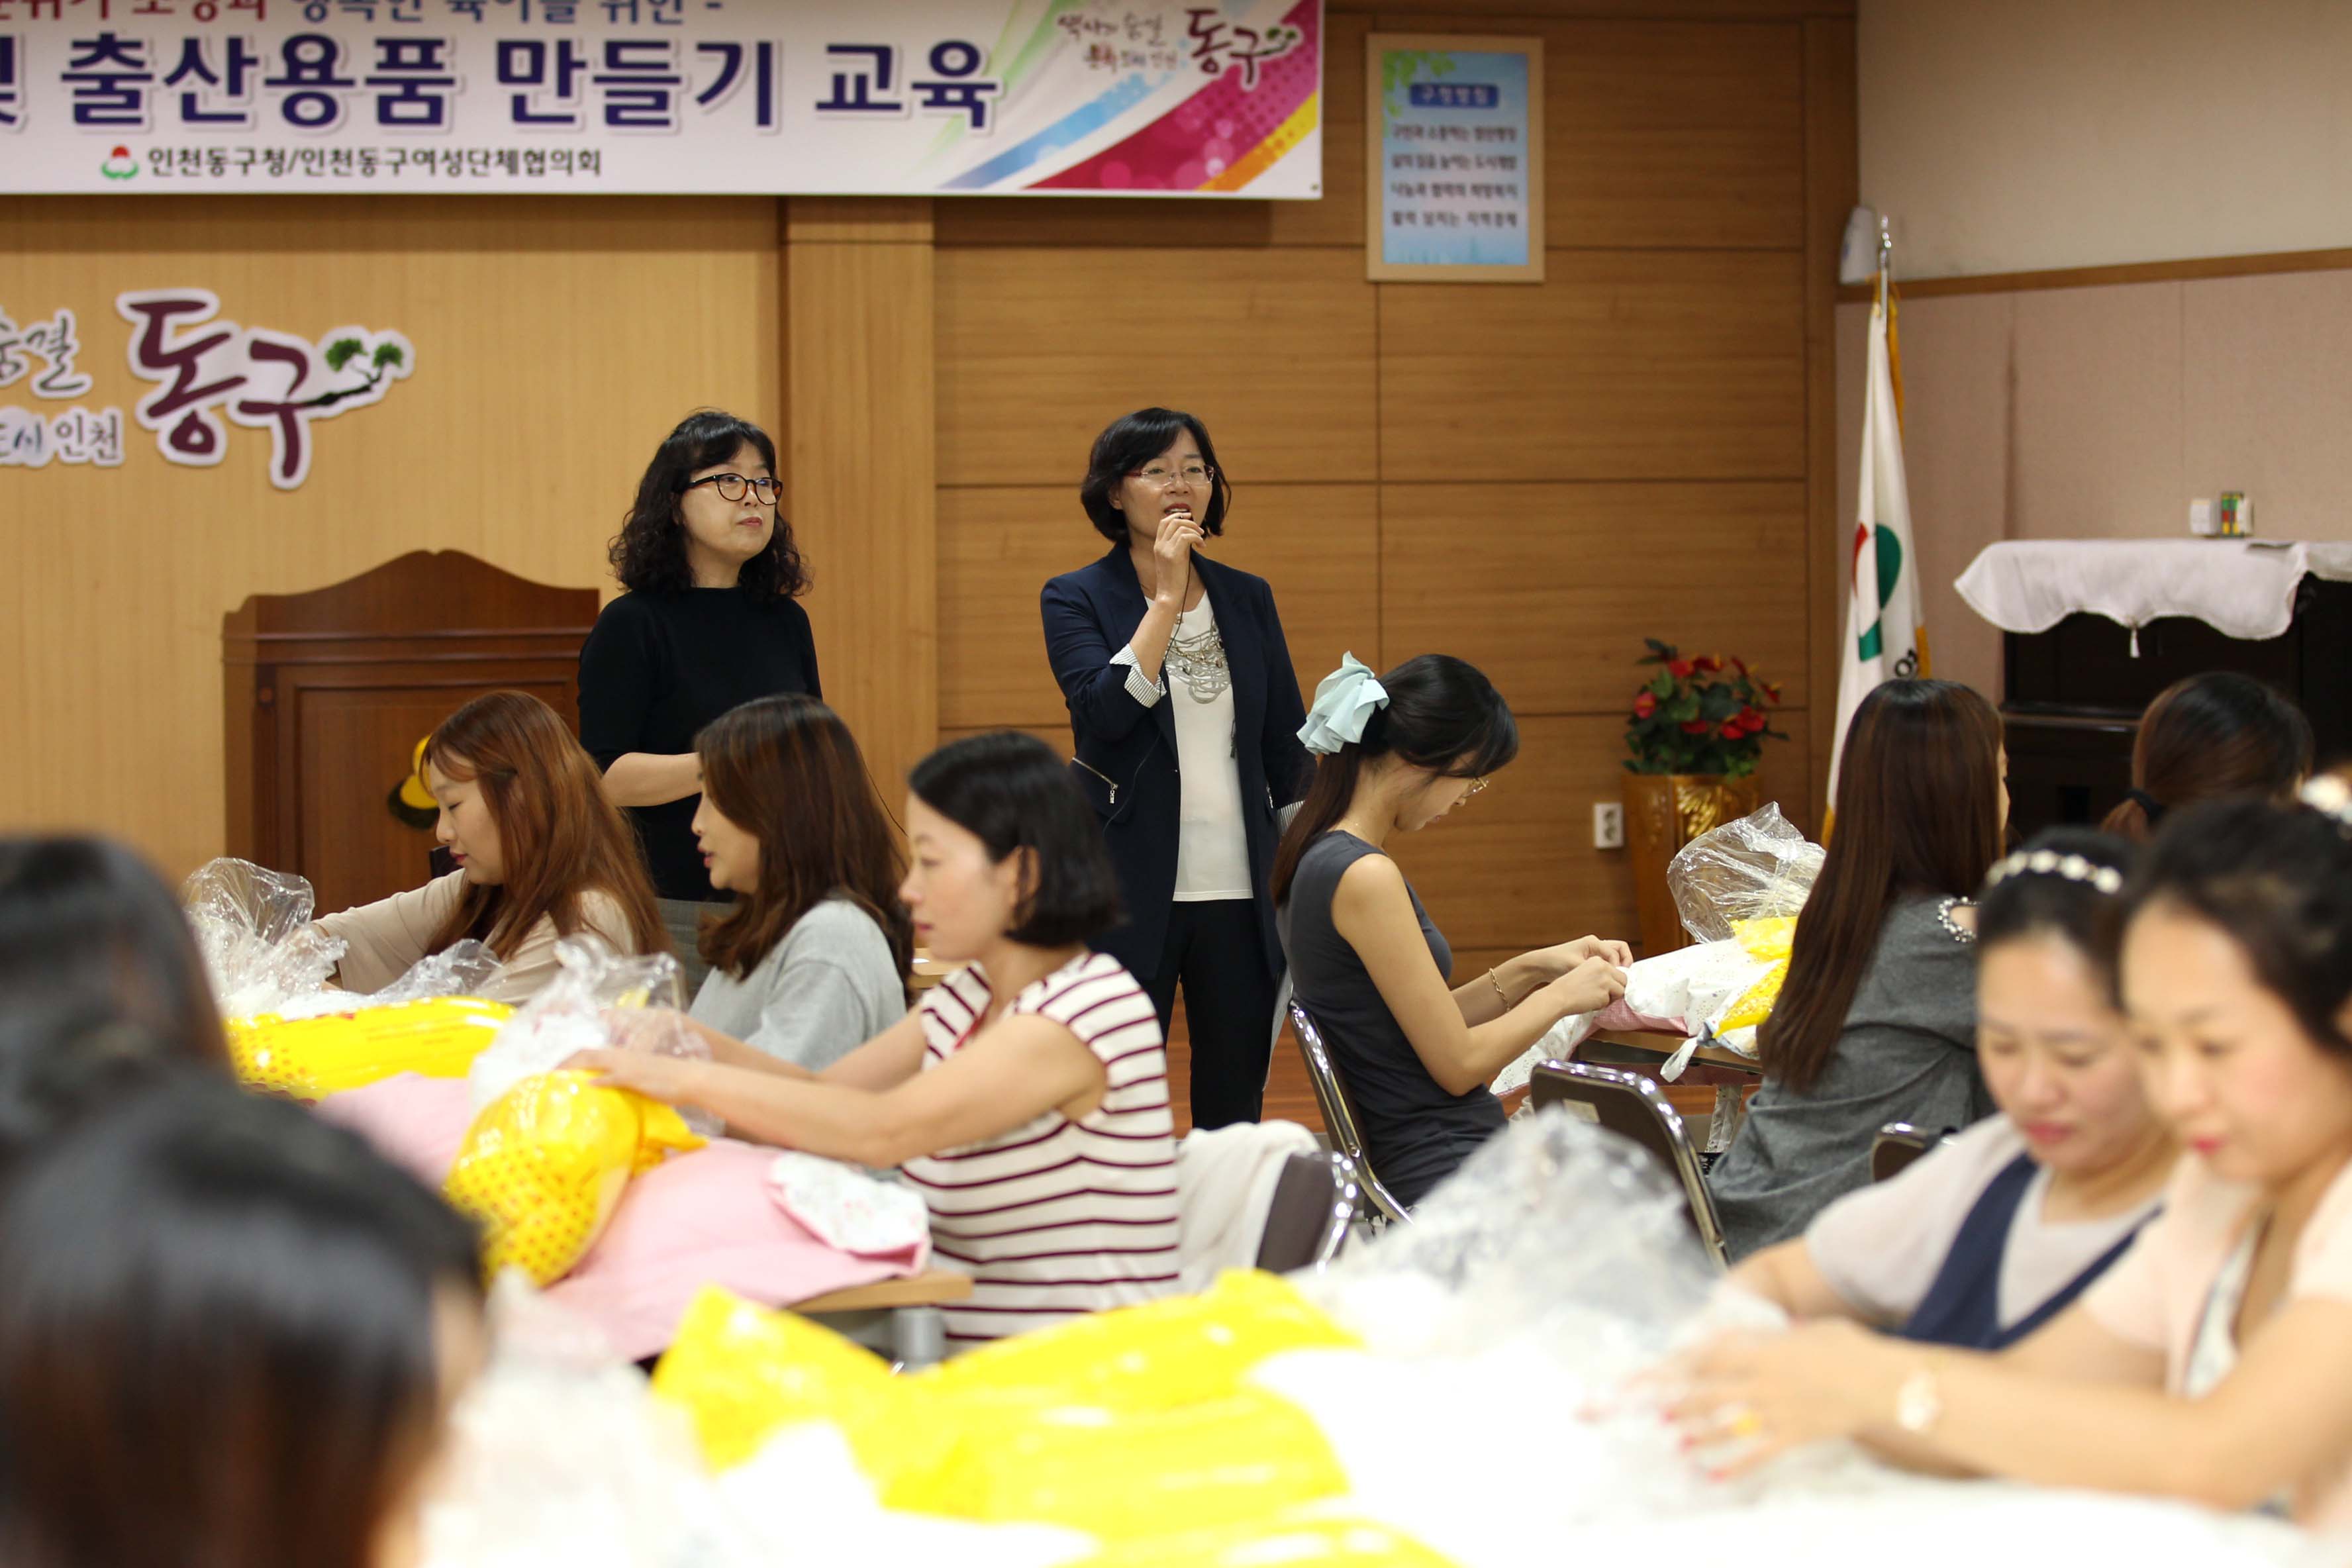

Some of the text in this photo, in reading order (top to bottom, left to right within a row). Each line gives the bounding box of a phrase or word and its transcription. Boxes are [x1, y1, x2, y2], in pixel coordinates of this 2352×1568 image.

[62, 33, 457, 126] 출산용품
[496, 38, 772, 127] 만들기
[814, 40, 997, 128] 교육
[1185, 9, 1271, 85] 동구
[147, 146, 602, 177] 인천동구청/인천동구여성단체협의회
[127, 299, 315, 479] 동구
[56, 414, 118, 460] 인천
